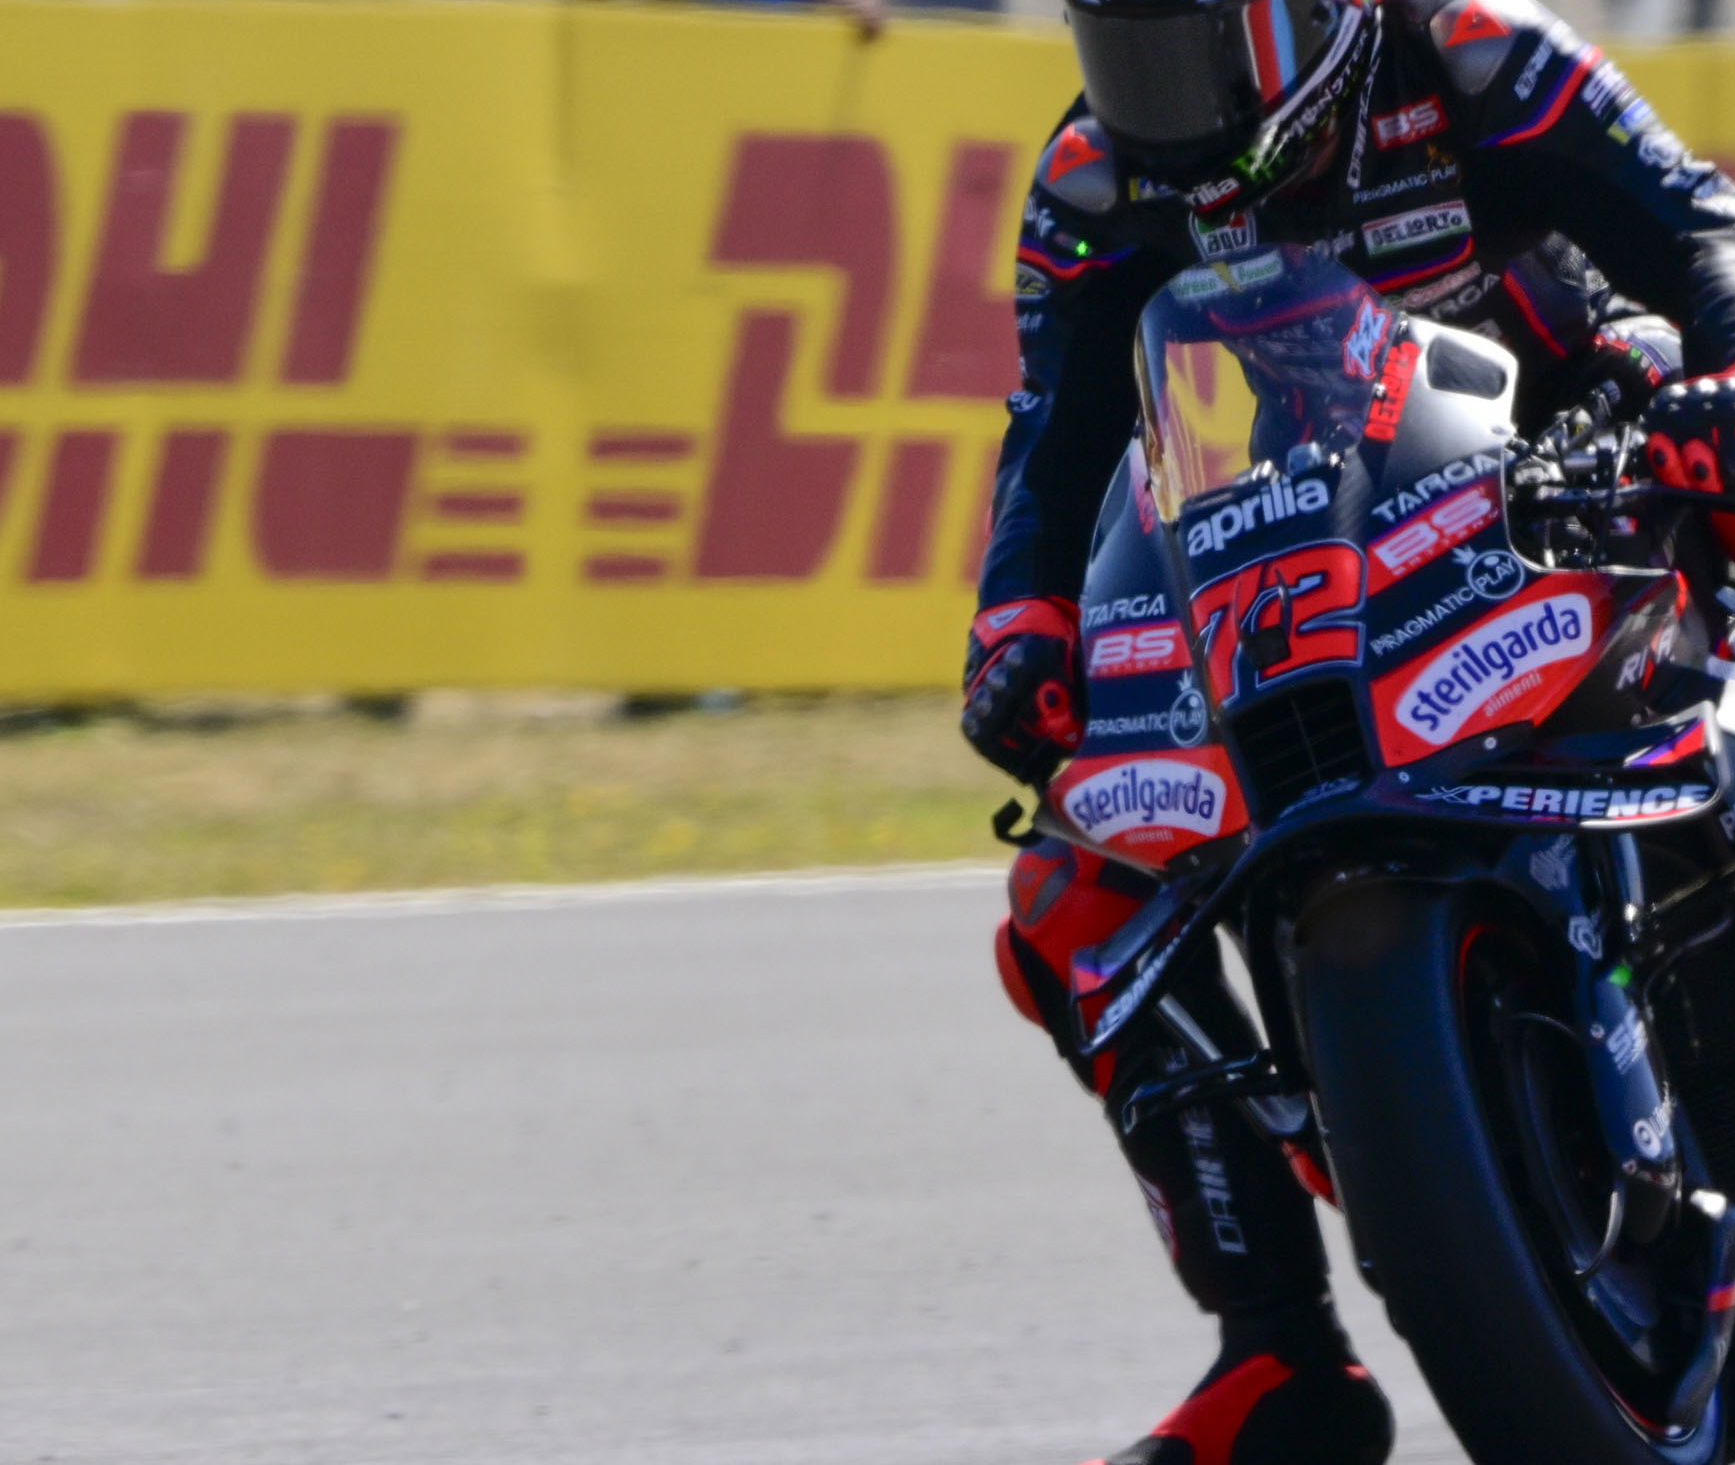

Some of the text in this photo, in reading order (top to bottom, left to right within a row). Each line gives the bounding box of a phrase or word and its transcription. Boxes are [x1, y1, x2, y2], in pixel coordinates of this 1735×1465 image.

[1187, 477, 1330, 556] aprilia
[1371, 451, 1512, 523] TARGA
[1374, 488, 1493, 568] BS
[1086, 593, 1167, 627] TARGA
[1475, 558, 1517, 594] PLAY
[1090, 626, 1179, 667] BS
[1192, 541, 1366, 708] 72
[1370, 586, 1475, 656] PRAGMATIC
[1411, 602, 1582, 732] sterilgarda
[1088, 711, 1170, 738] PRAGMATIC
[1071, 762, 1217, 831] sterilgarda
[1416, 783, 1711, 819] XPERIENCE
